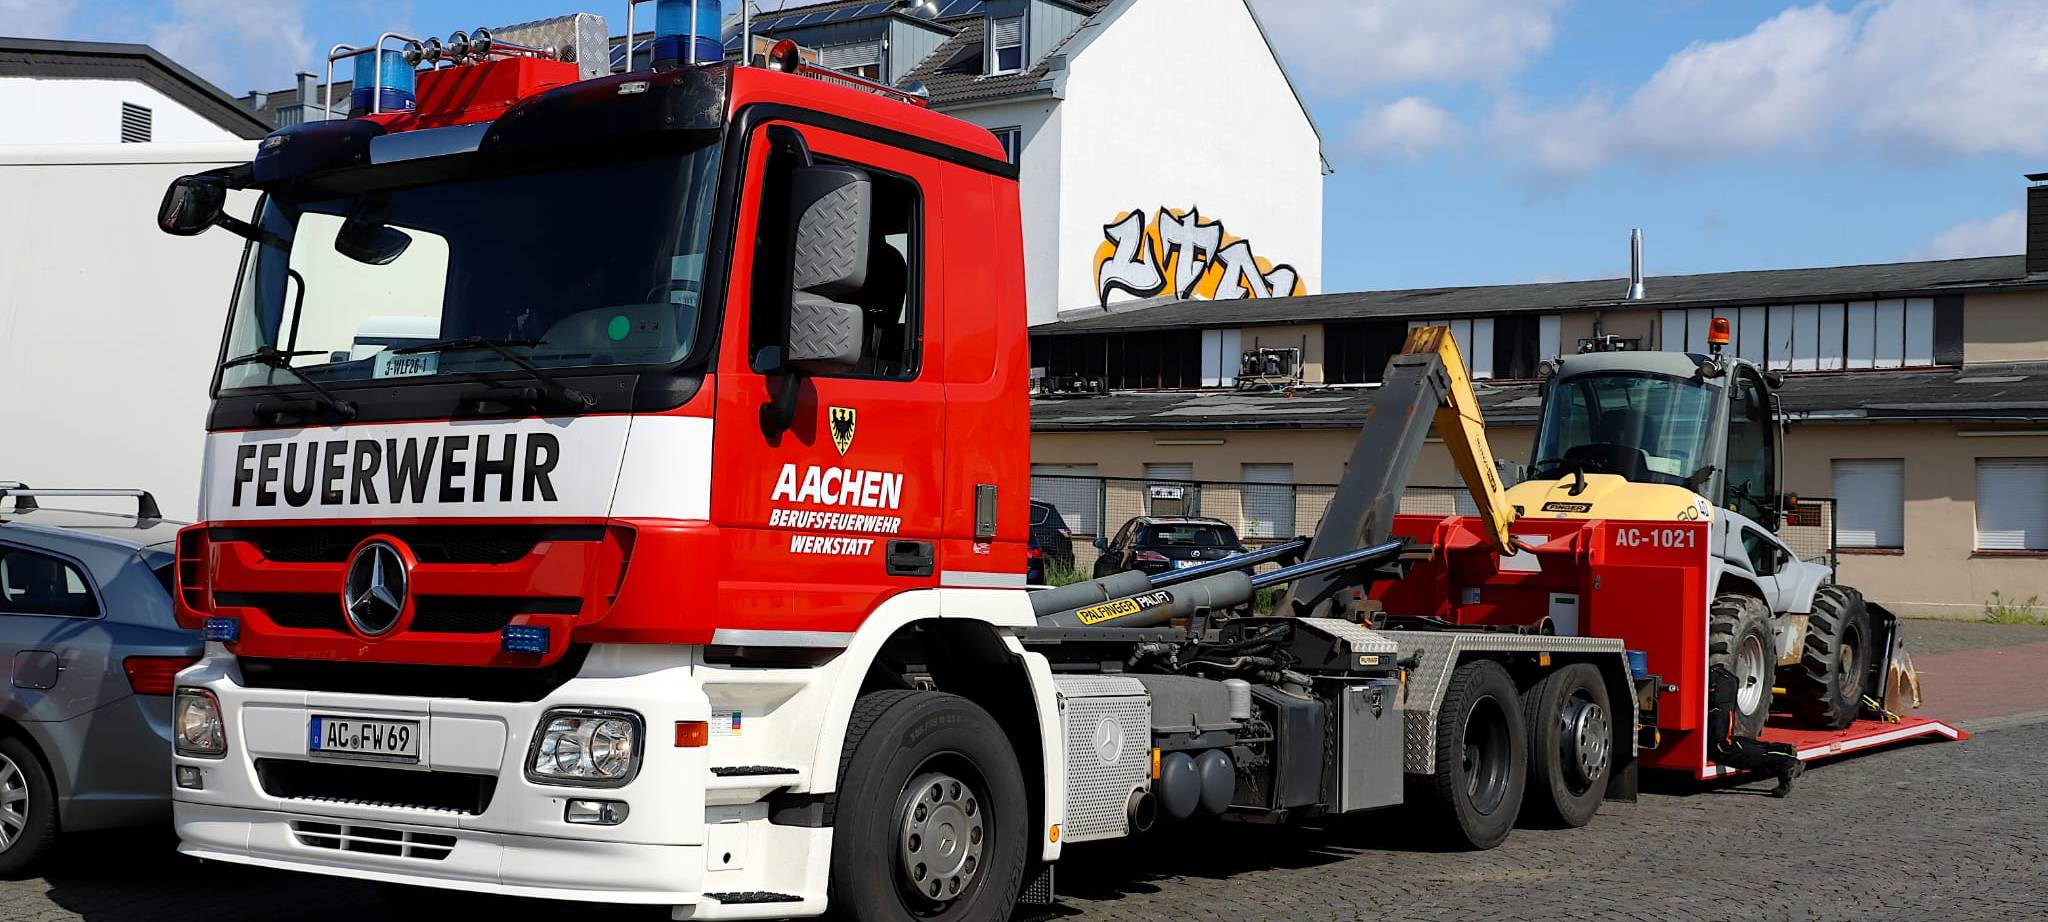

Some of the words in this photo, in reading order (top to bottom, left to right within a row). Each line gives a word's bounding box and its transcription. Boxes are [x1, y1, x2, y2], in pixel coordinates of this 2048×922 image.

[384, 356, 428, 376] 3-WLF26-1
[232, 432, 560, 507] FEUERWEHR
[771, 463, 904, 510] AACHEN
[769, 508, 902, 534] BERUFSFEUERWEHR
[790, 535, 875, 556] WERKSTATT
[1616, 528, 1695, 548] AC-1021
[1079, 600, 1137, 623] PALFINGER
[1136, 591, 1172, 609] PALIFT
[327, 722, 349, 748] AC
[360, 723, 384, 750] FW
[387, 725, 410, 752] 69
